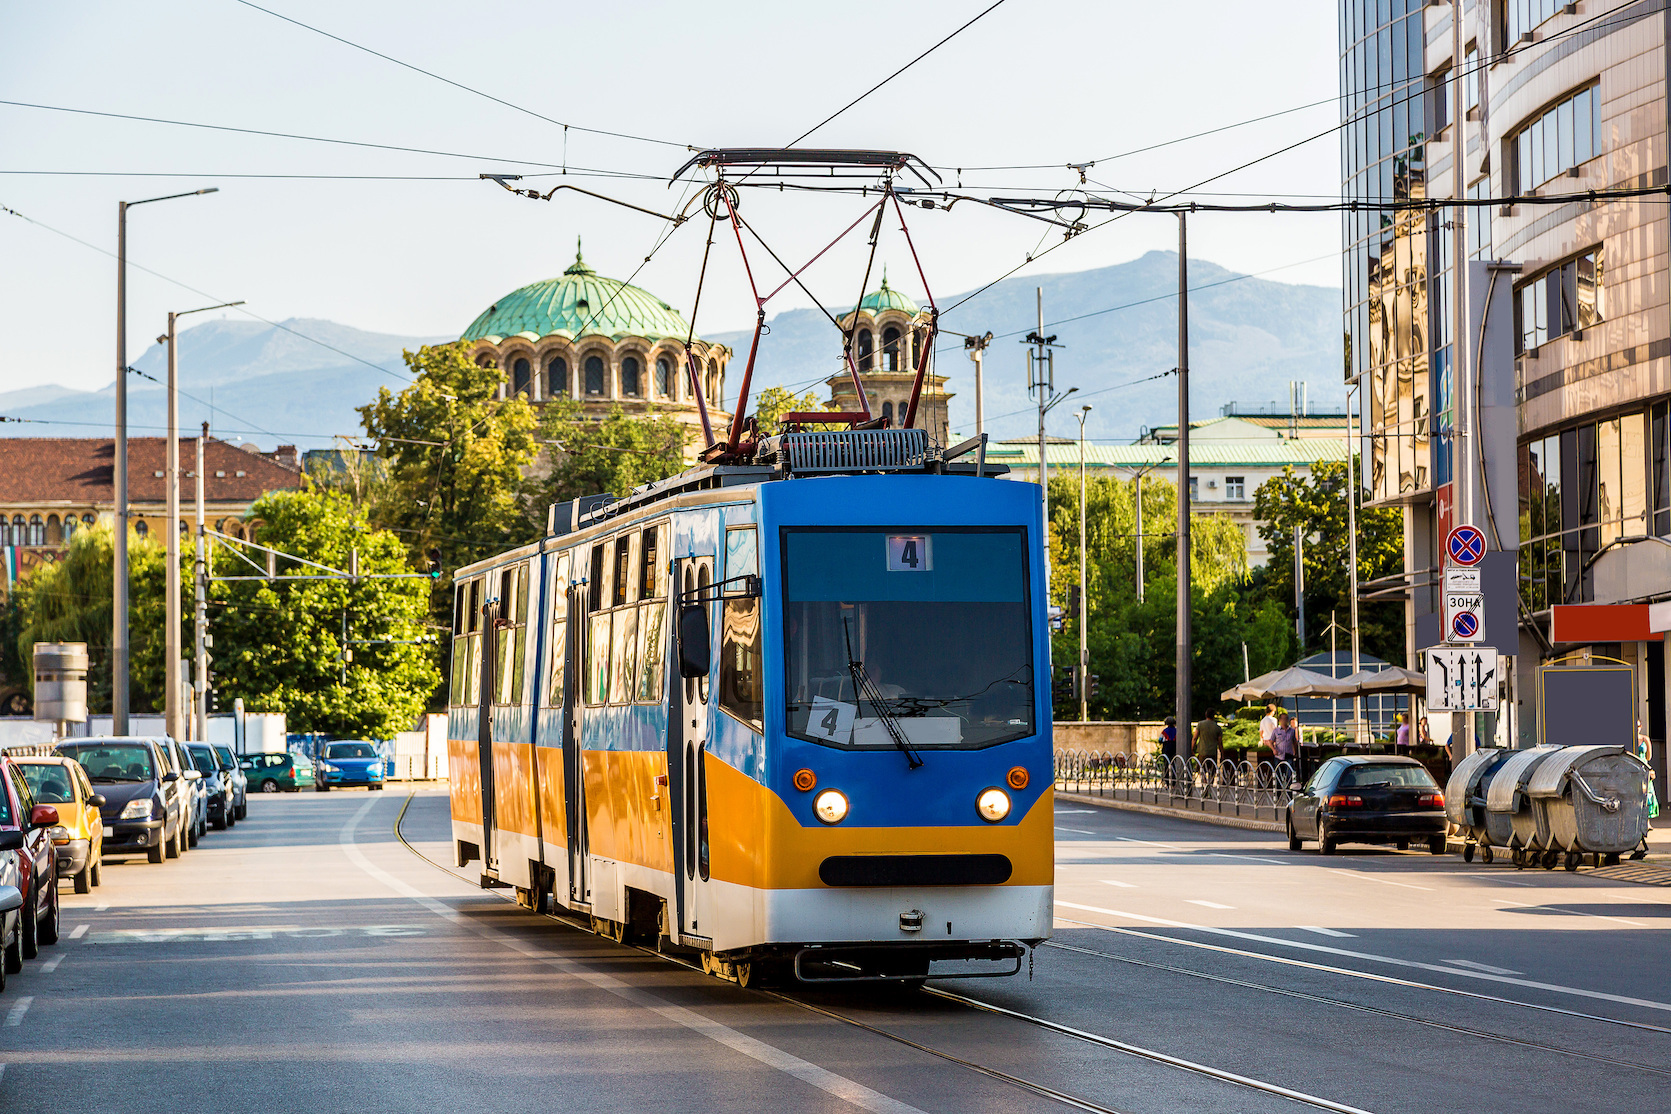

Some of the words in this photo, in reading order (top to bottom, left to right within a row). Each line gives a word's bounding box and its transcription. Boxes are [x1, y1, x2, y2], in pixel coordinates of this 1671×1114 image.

[901, 540, 919, 568] 4
[1449, 597, 1481, 607] ЗОНА
[821, 708, 838, 736] 4
